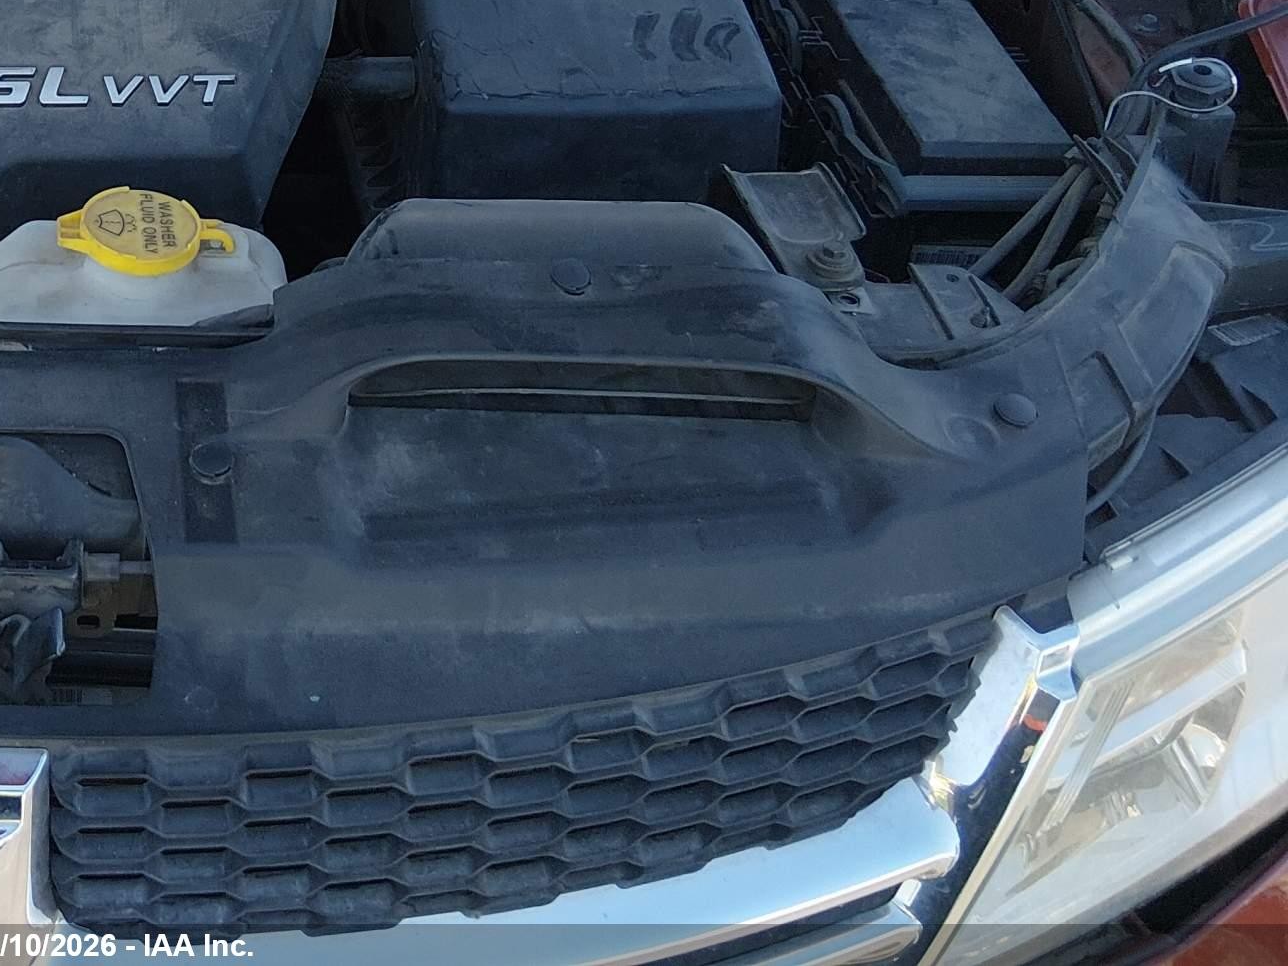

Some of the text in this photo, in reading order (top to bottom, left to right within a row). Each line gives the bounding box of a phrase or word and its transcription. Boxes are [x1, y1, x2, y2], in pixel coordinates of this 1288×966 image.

[103, 74, 237, 106] VVT
[140, 194, 158, 254] FLUID ONLY
[158, 202, 177, 247] WASHER
